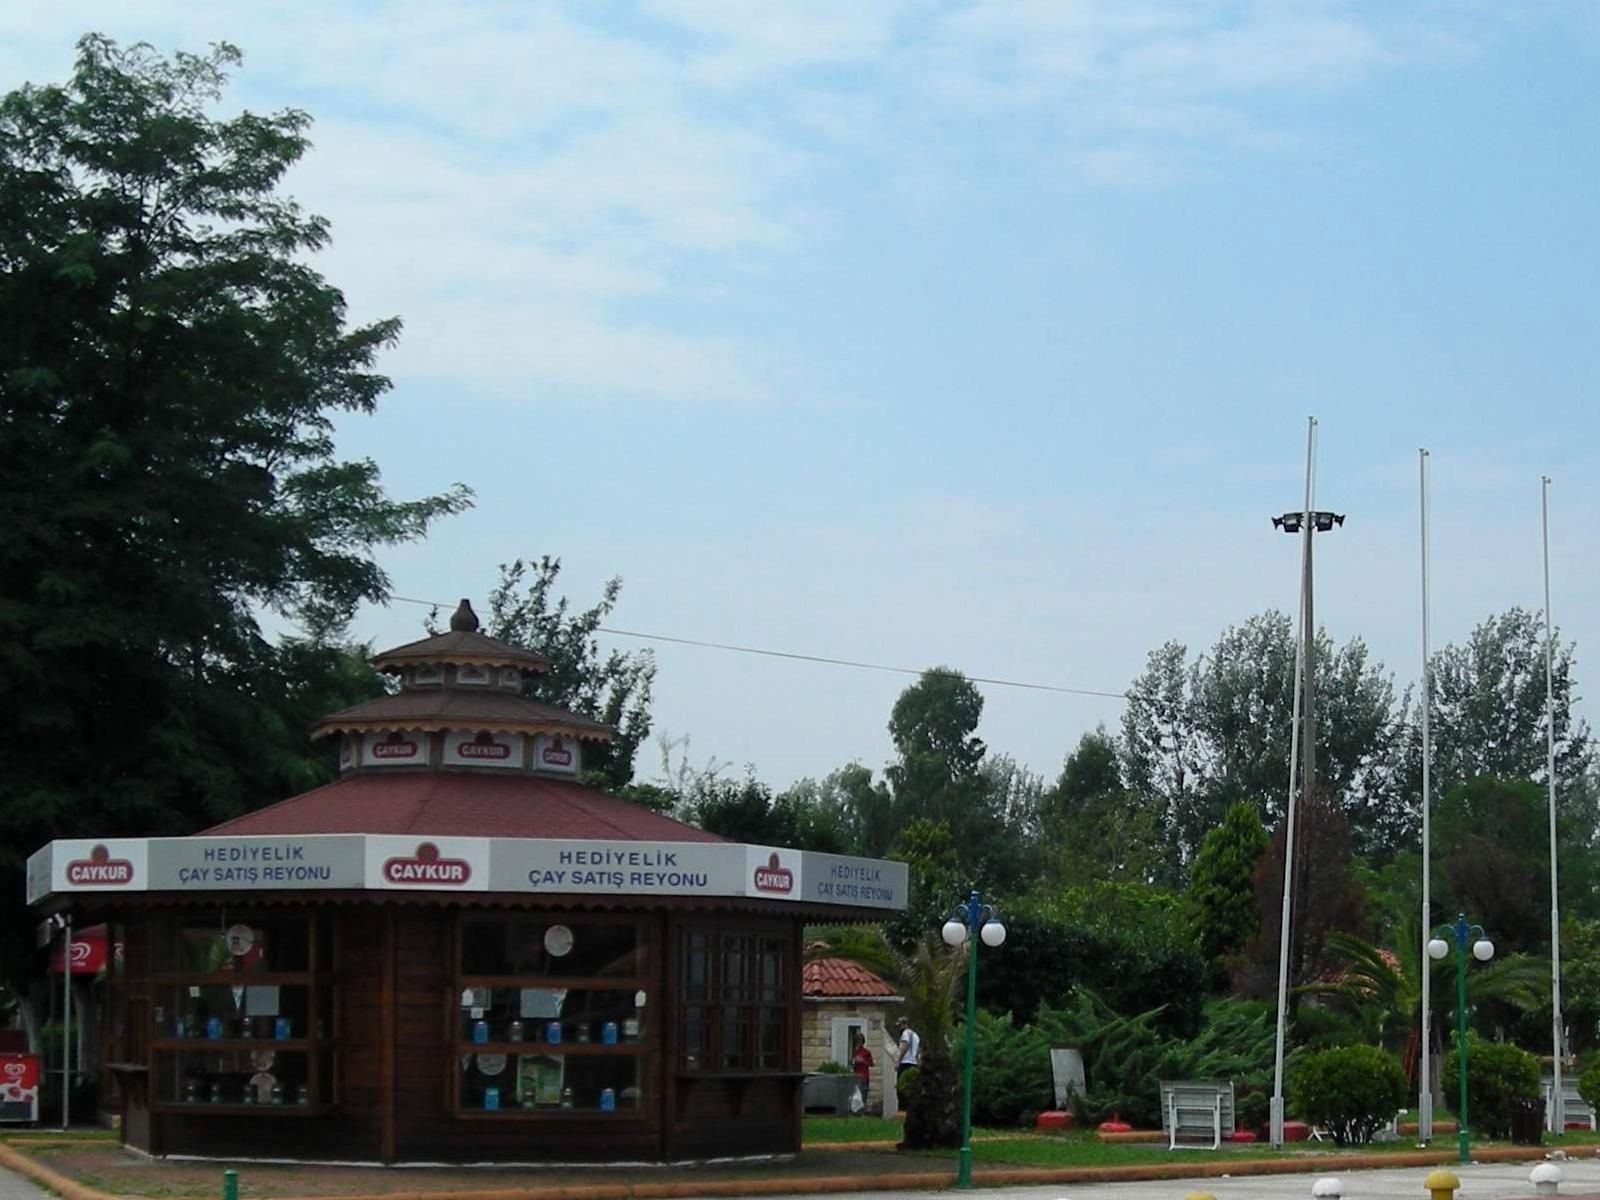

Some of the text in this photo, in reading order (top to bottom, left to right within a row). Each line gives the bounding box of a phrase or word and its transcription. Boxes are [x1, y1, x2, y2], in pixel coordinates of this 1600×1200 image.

[203, 844, 304, 861] HEDİYELİK
[559, 849, 678, 866] HEDİYELİK
[178, 866, 331, 885] ÇAY SATIŞ REYONU
[527, 870, 708, 888] ÇAY SATIŞ REYONU
